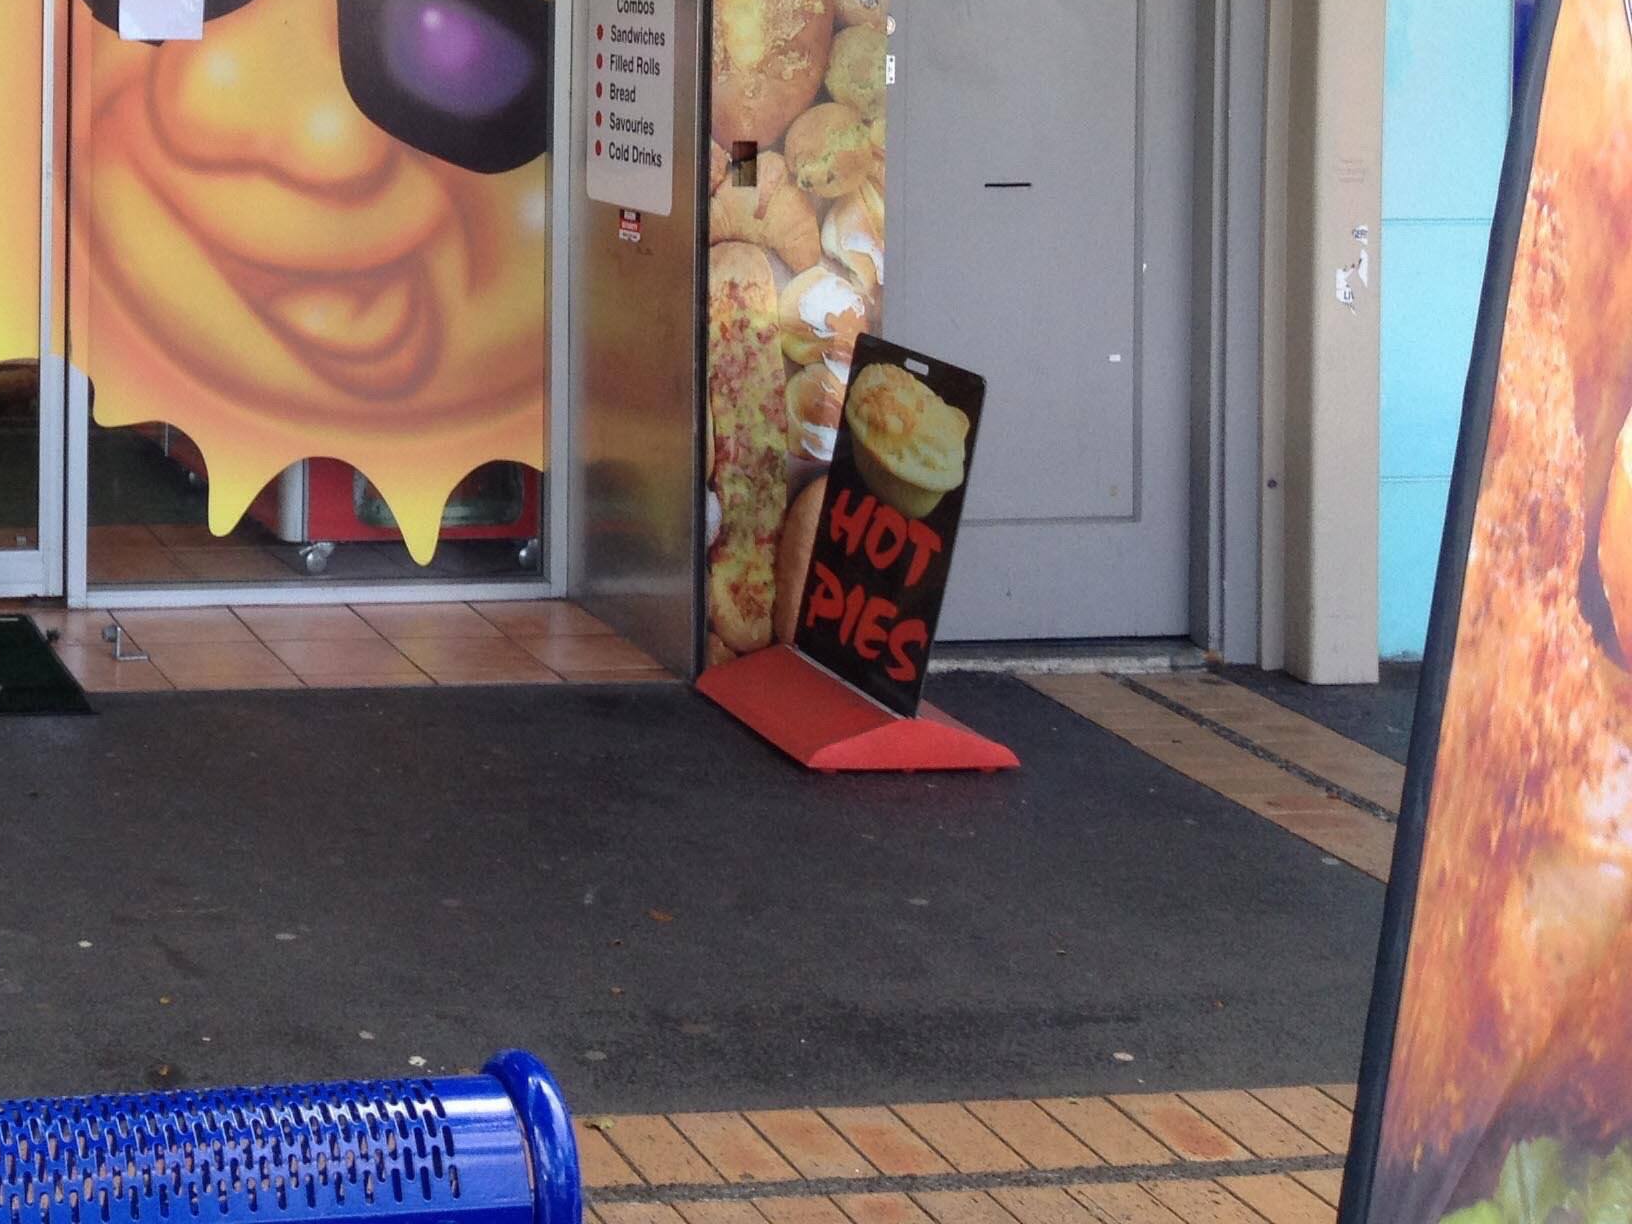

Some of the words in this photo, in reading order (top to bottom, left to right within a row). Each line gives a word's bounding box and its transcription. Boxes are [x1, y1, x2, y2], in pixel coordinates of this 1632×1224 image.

[610, 24, 665, 47] Sandwiches
[610, 53, 634, 74] Filled
[636, 56, 661, 76] Rolls
[609, 82, 636, 103] Bread
[609, 112, 655, 136] Savouries
[608, 142, 630, 163] Cold
[632, 145, 663, 168] Drinks
[830, 488, 942, 588] HOT
[806, 561, 928, 682] PIES
